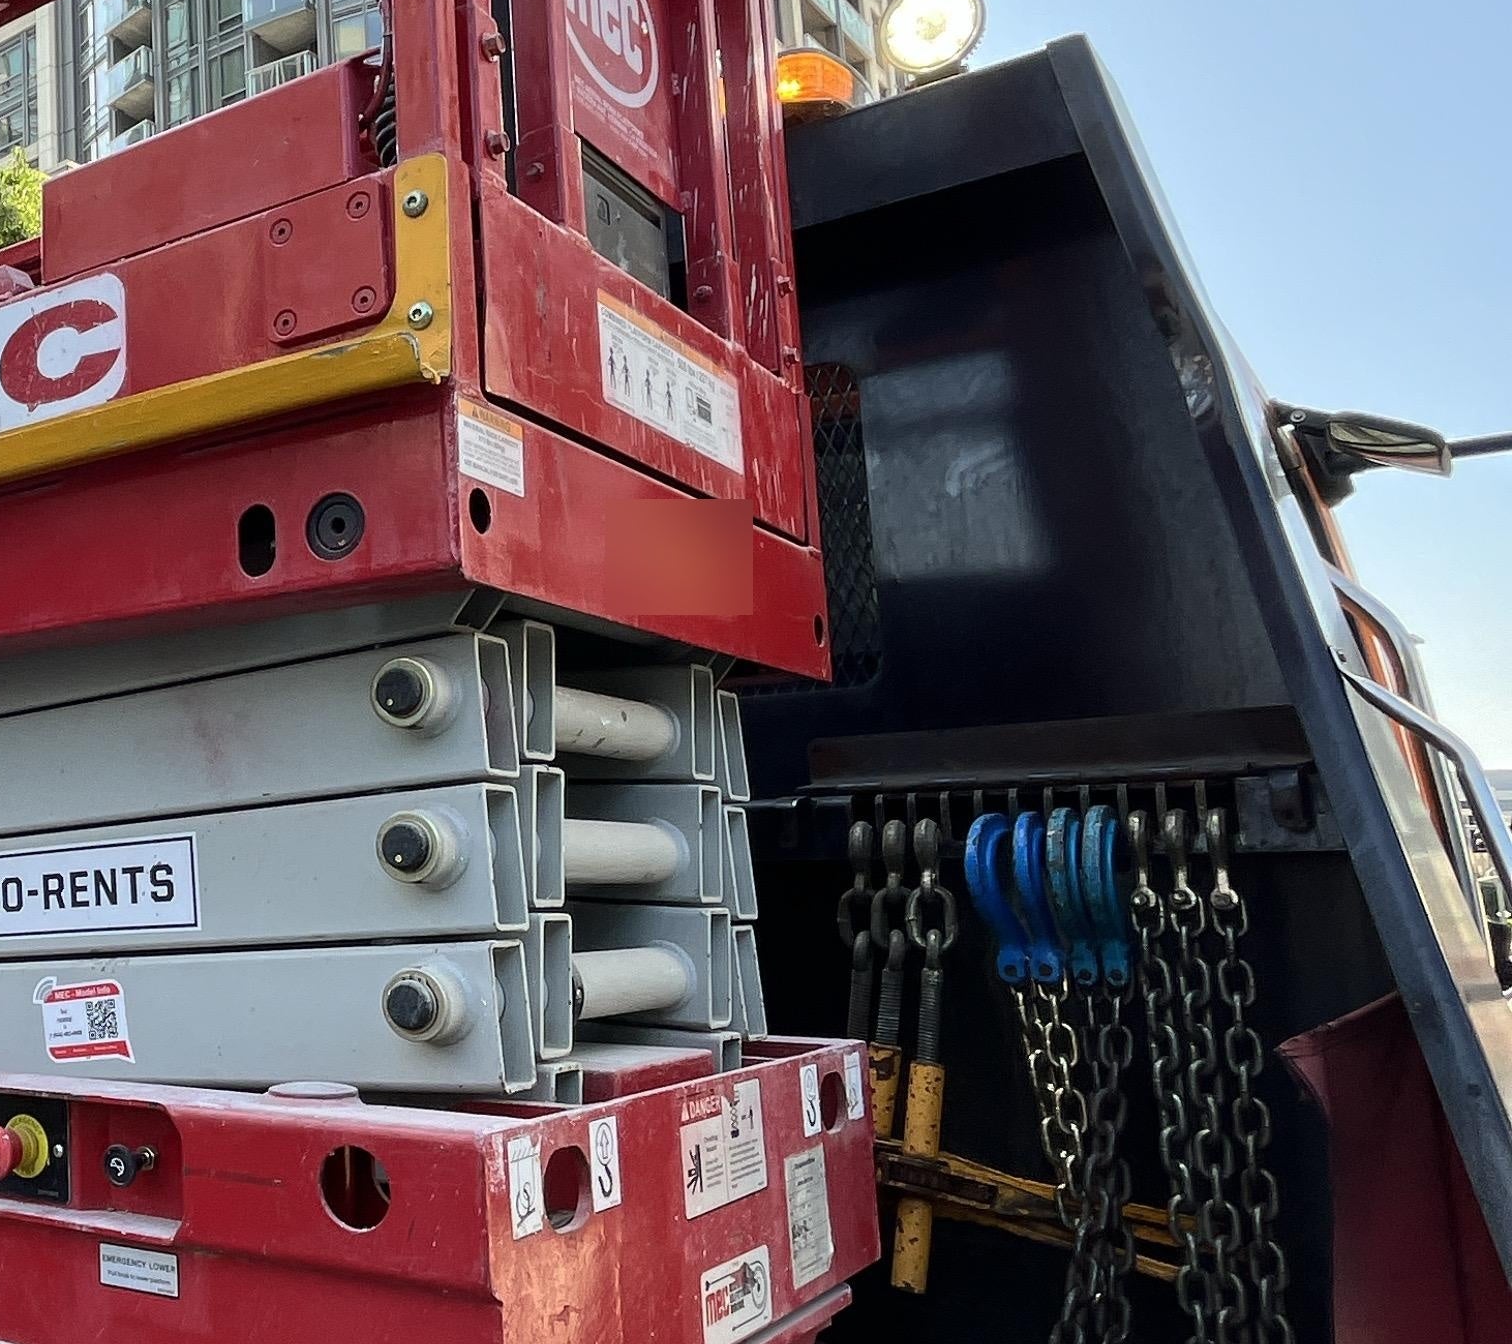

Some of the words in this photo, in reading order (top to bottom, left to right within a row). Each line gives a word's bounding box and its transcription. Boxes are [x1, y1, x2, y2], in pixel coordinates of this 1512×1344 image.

[689, 1096, 722, 1116] DANGER
[102, 1254, 147, 1268] EMERGENCY
[149, 1262, 176, 1273] LOWER
